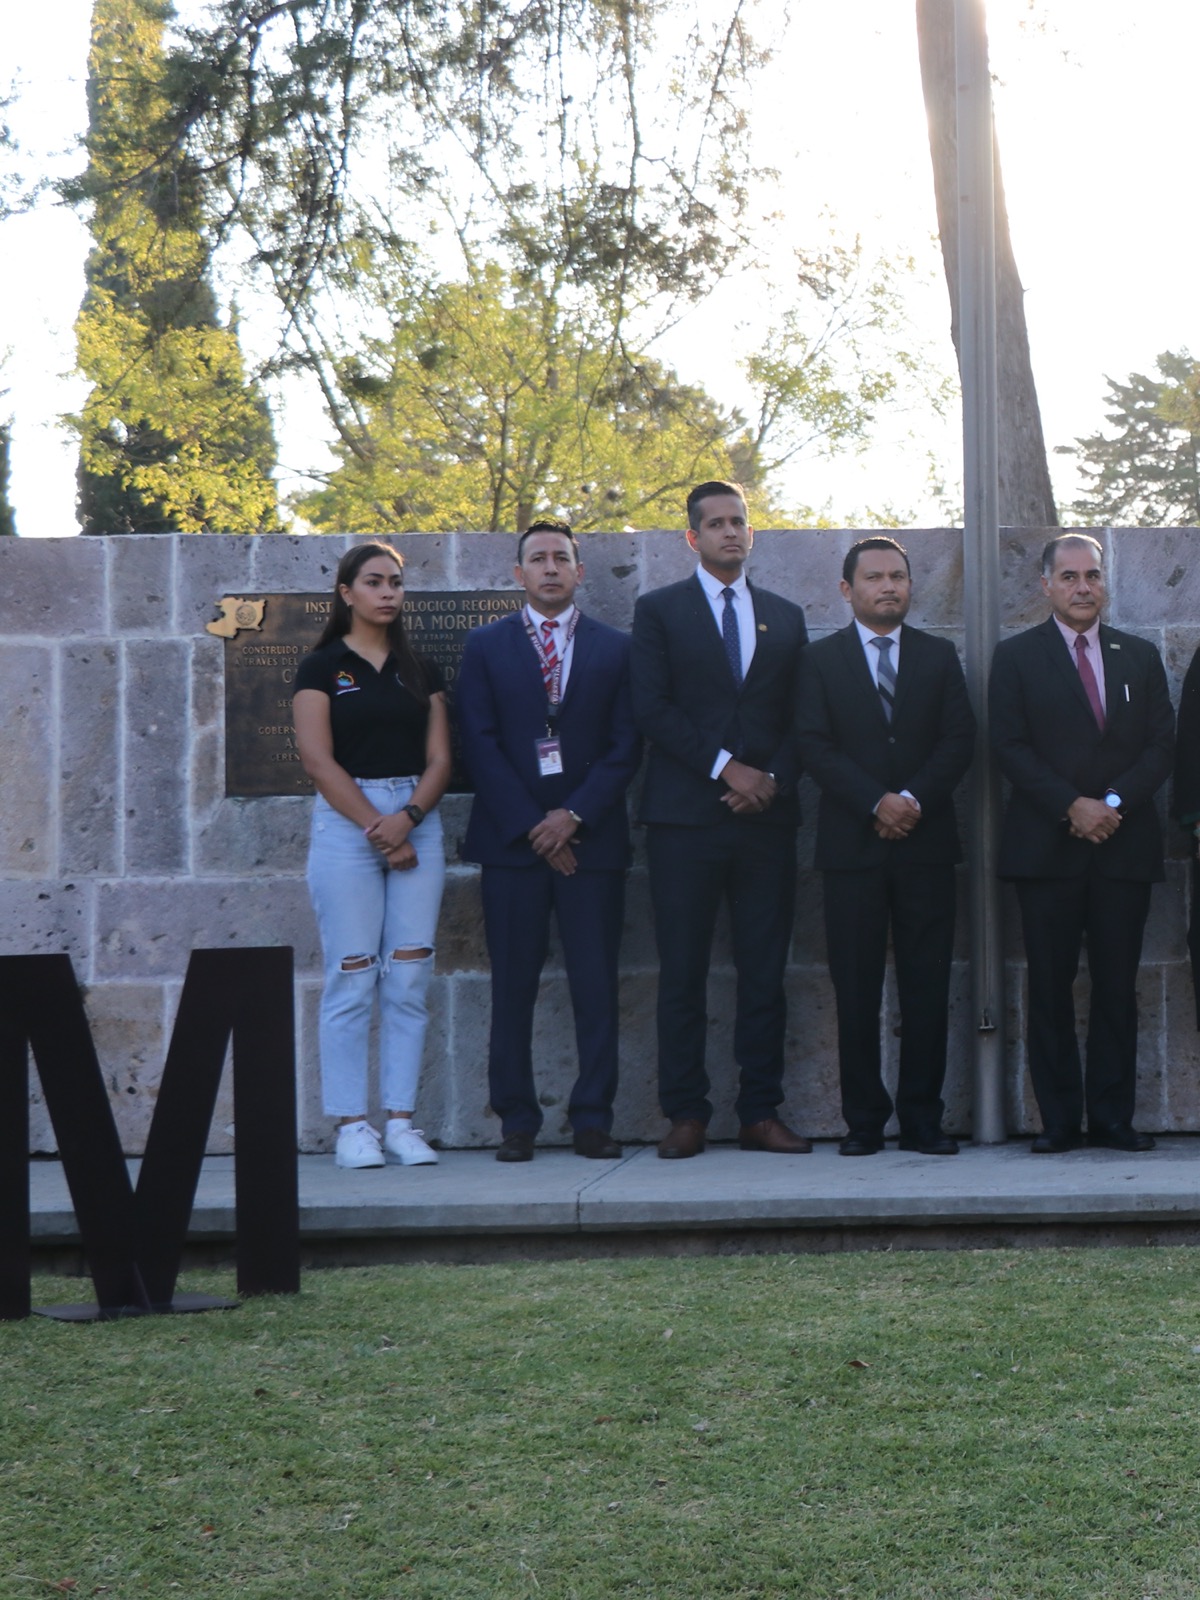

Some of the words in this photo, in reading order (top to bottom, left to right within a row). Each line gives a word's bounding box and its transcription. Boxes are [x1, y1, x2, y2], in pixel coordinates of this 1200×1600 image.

[402, 600, 457, 612] OLOGICO
[462, 599, 523, 612] REGIONAL
[401, 615, 425, 630] RIA
[431, 614, 509, 630] MORELO
[242, 646, 299, 655] CONSTRUIDO
[244, 657, 278, 666] TRAVES
[282, 657, 299, 666] DEL
[258, 726, 297, 735] GOBERN
[271, 752, 300, 761] GEREN
